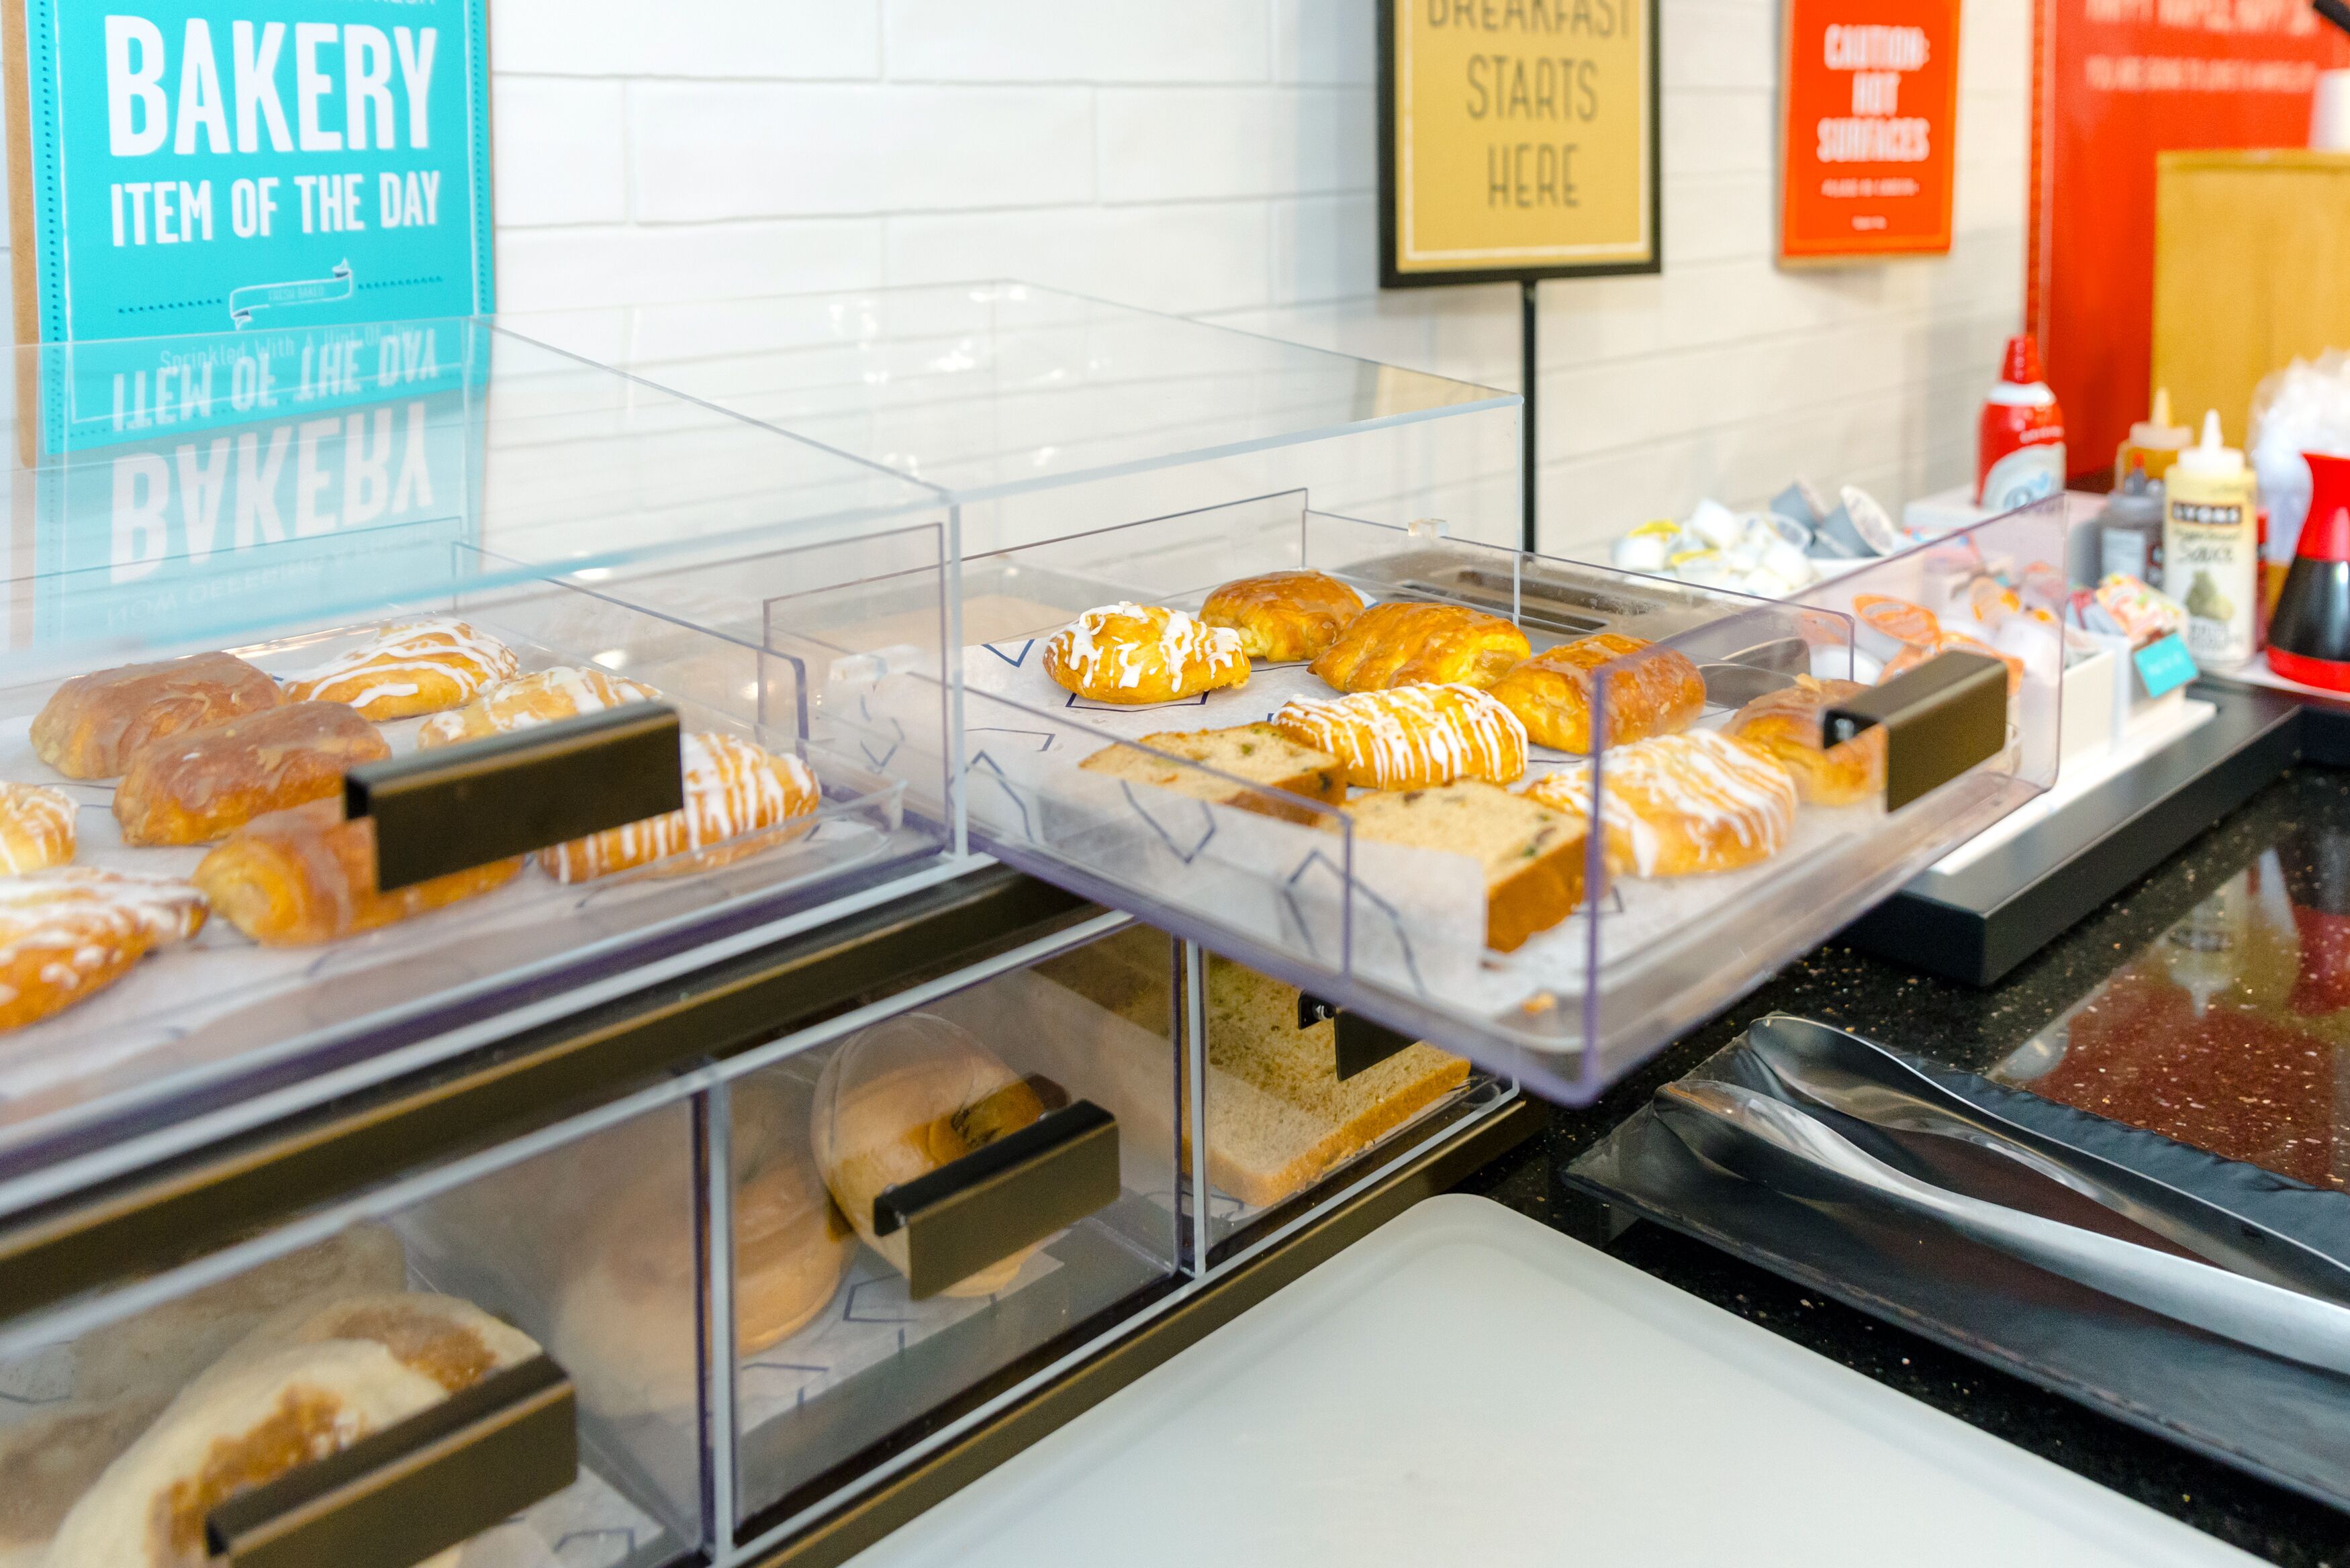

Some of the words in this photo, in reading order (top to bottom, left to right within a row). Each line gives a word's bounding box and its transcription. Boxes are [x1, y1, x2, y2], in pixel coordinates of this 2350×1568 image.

[104, 15, 437, 156] BAKERY
[1466, 53, 1599, 122] STARTS
[1817, 117, 1930, 162] SURFACES
[1487, 142, 1581, 208] HERE
[111, 179, 213, 247] ITEM
[231, 177, 279, 238] OF
[294, 174, 365, 234] THE
[380, 170, 440, 229] DAY
[269, 288, 295, 301] FRESH
[297, 285, 325, 299] BAKED
[160, 340, 246, 369] Sprinkled
